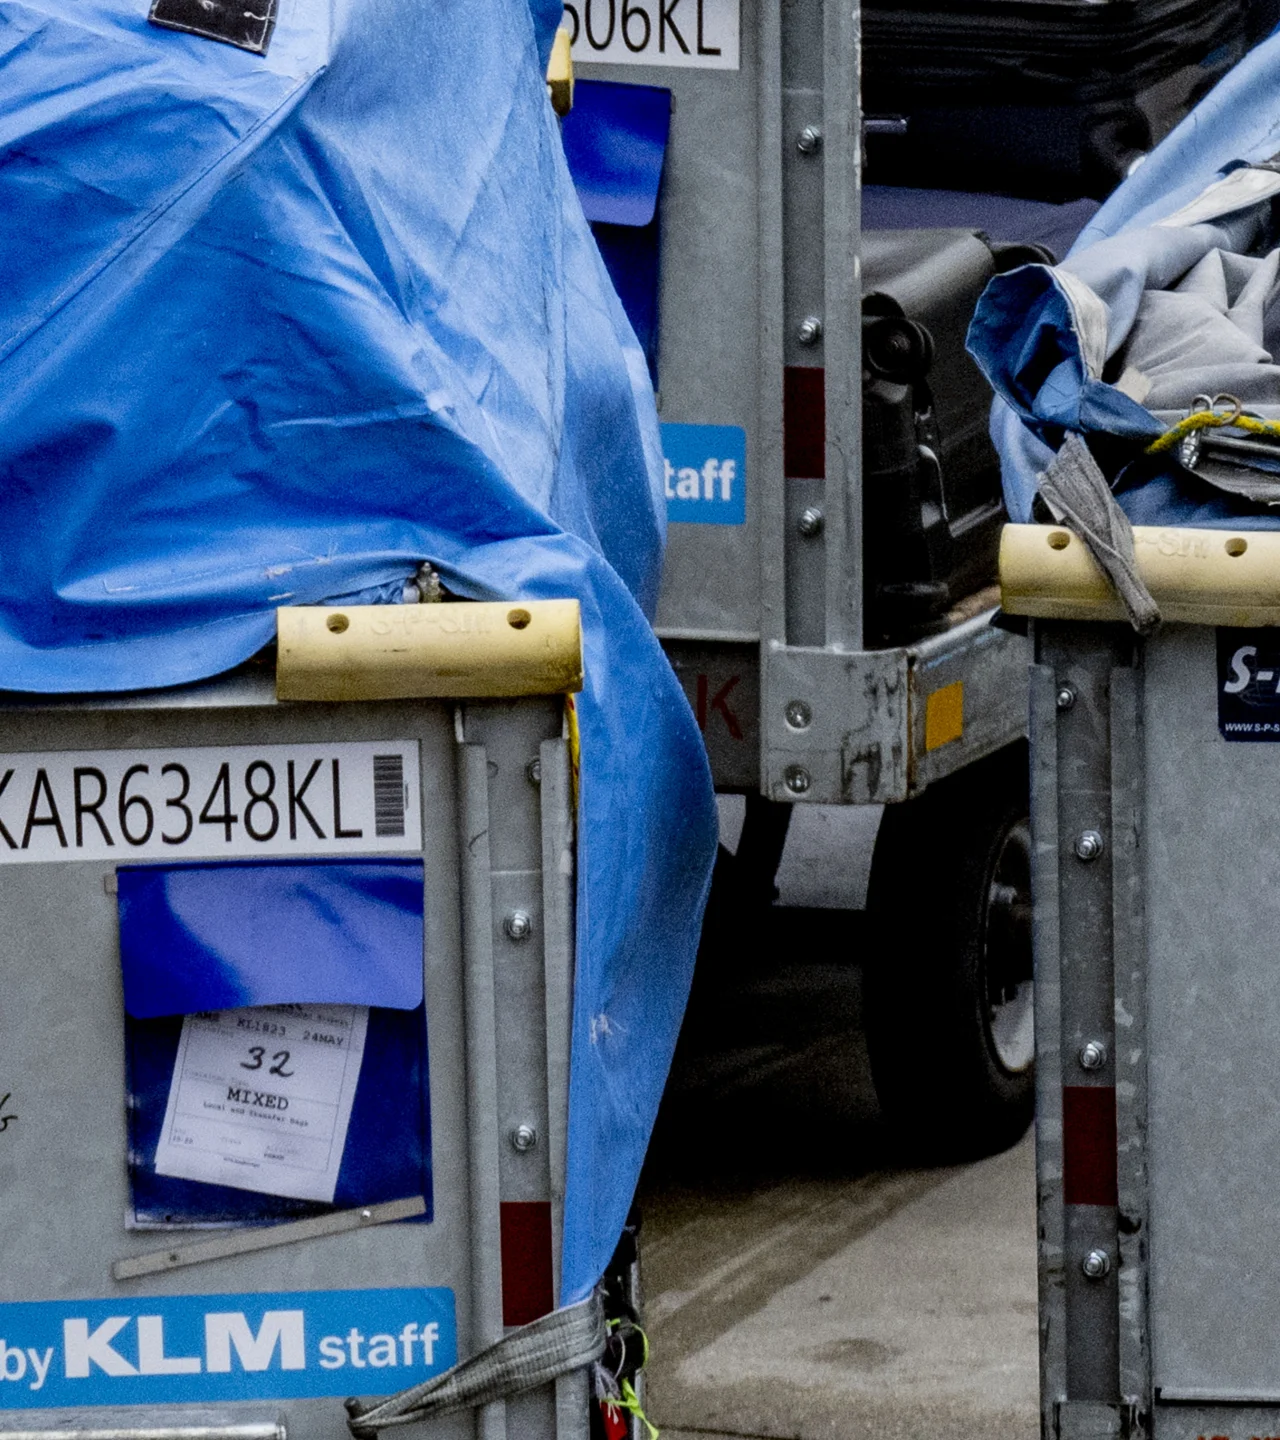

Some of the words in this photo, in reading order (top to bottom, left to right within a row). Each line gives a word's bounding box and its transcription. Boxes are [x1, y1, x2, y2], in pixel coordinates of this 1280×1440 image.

[664, 457, 736, 501] taff
[302, 1030, 344, 1046] 24MAY
[239, 1046, 295, 1078] 32
[226, 1086, 290, 1111] MIXED
[0, 1338, 53, 1391] by
[63, 1310, 306, 1379] KLM
[319, 1321, 440, 1370] staff
